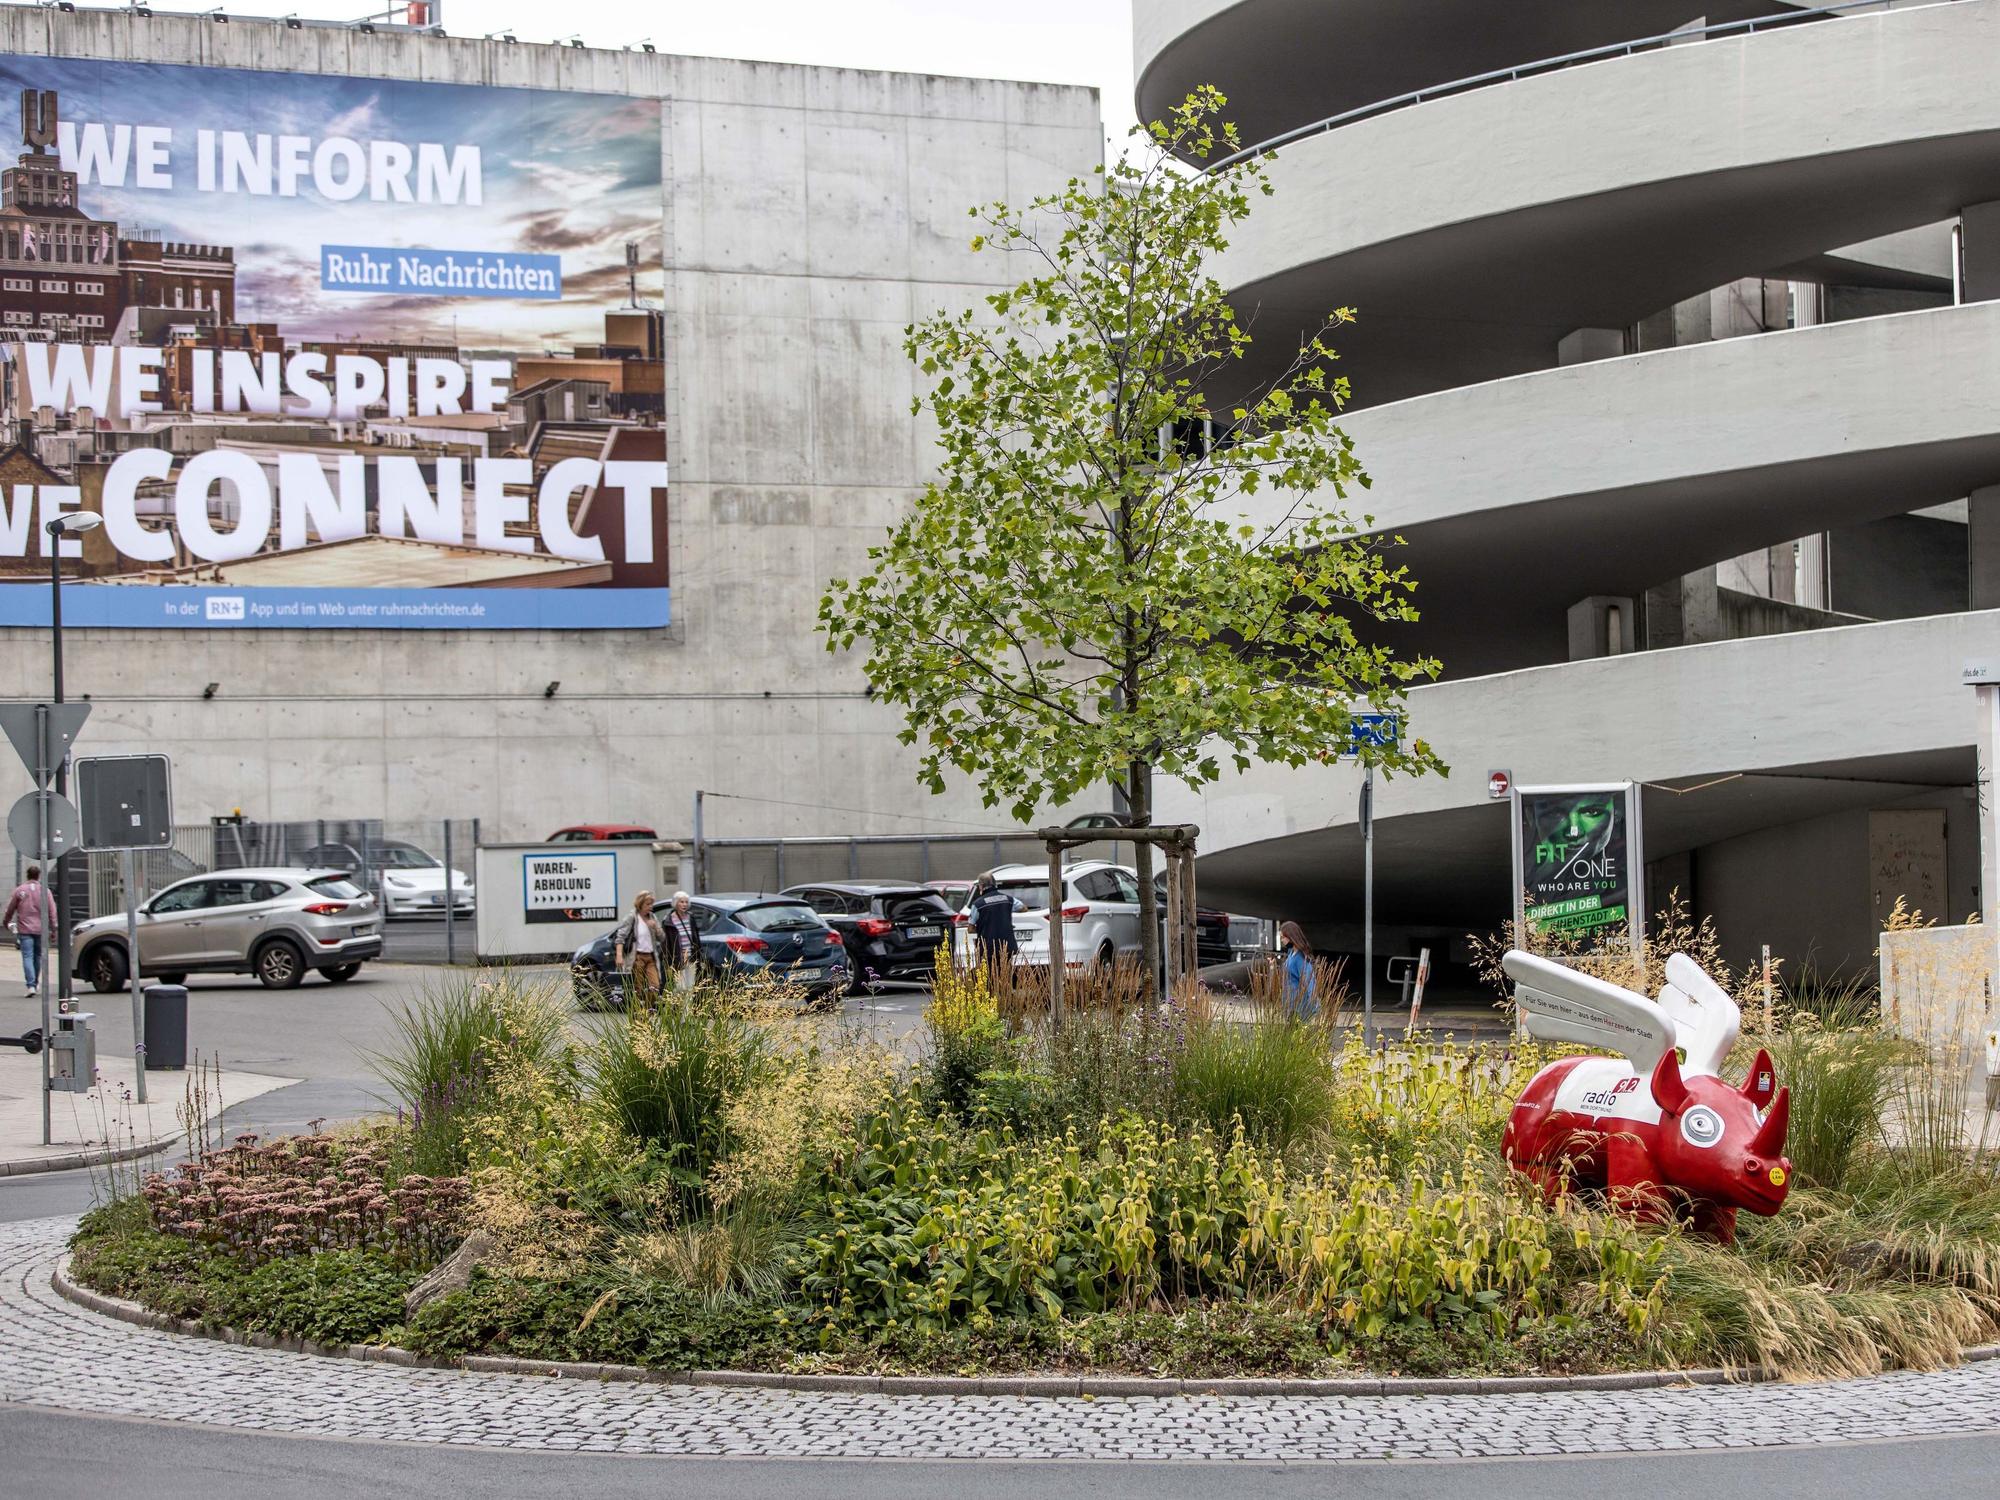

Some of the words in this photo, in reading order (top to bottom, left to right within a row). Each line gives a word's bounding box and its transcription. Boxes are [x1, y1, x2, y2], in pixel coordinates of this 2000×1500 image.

[57, 121, 172, 189] WE
[197, 129, 483, 205] INFORM
[327, 253, 391, 284] Ruhr
[398, 256, 556, 291] Nachrichten
[24, 341, 163, 419] WE
[191, 349, 512, 419] INSPIRE
[102, 447, 668, 564] CONNECT
[165, 602, 177, 615] In
[179, 602, 199, 615] der
[210, 602, 241, 615] RN+
[250, 603, 273, 617] App
[276, 603, 299, 616] und
[302, 603, 316, 616] im
[319, 603, 345, 616] Web
[348, 604, 378, 616] unter
[380, 603, 486, 617] ruhrnachrichten.de
[1536, 843, 1568, 864] FIT
[533, 862, 578, 875] WAREN-
[1573, 858, 1616, 879] ONE
[534, 877, 591, 891] ABHOLUNG
[1538, 883, 1564, 892] WHO
[1567, 881, 1590, 891] ARE
[1594, 880, 1617, 890] YOU
[579, 907, 616, 920] SATURN
[1531, 903, 1565, 919] DIREKT
[1566, 901, 1577, 913] IN
[1578, 898, 1598, 910] DER
[1537, 998, 1547, 1007] Sie
[1548, 1003, 1559, 1011] von
[1560, 1004, 1572, 1014] hier
[1578, 1011, 1589, 1019] aus
[1590, 1013, 1603, 1024] dem
[1604, 1017, 1625, 1030] Herzen
[1625, 1025, 1636, 1033] der
[1637, 1028, 1653, 1039] Stadt
[1582, 1090, 1617, 1106] radio
